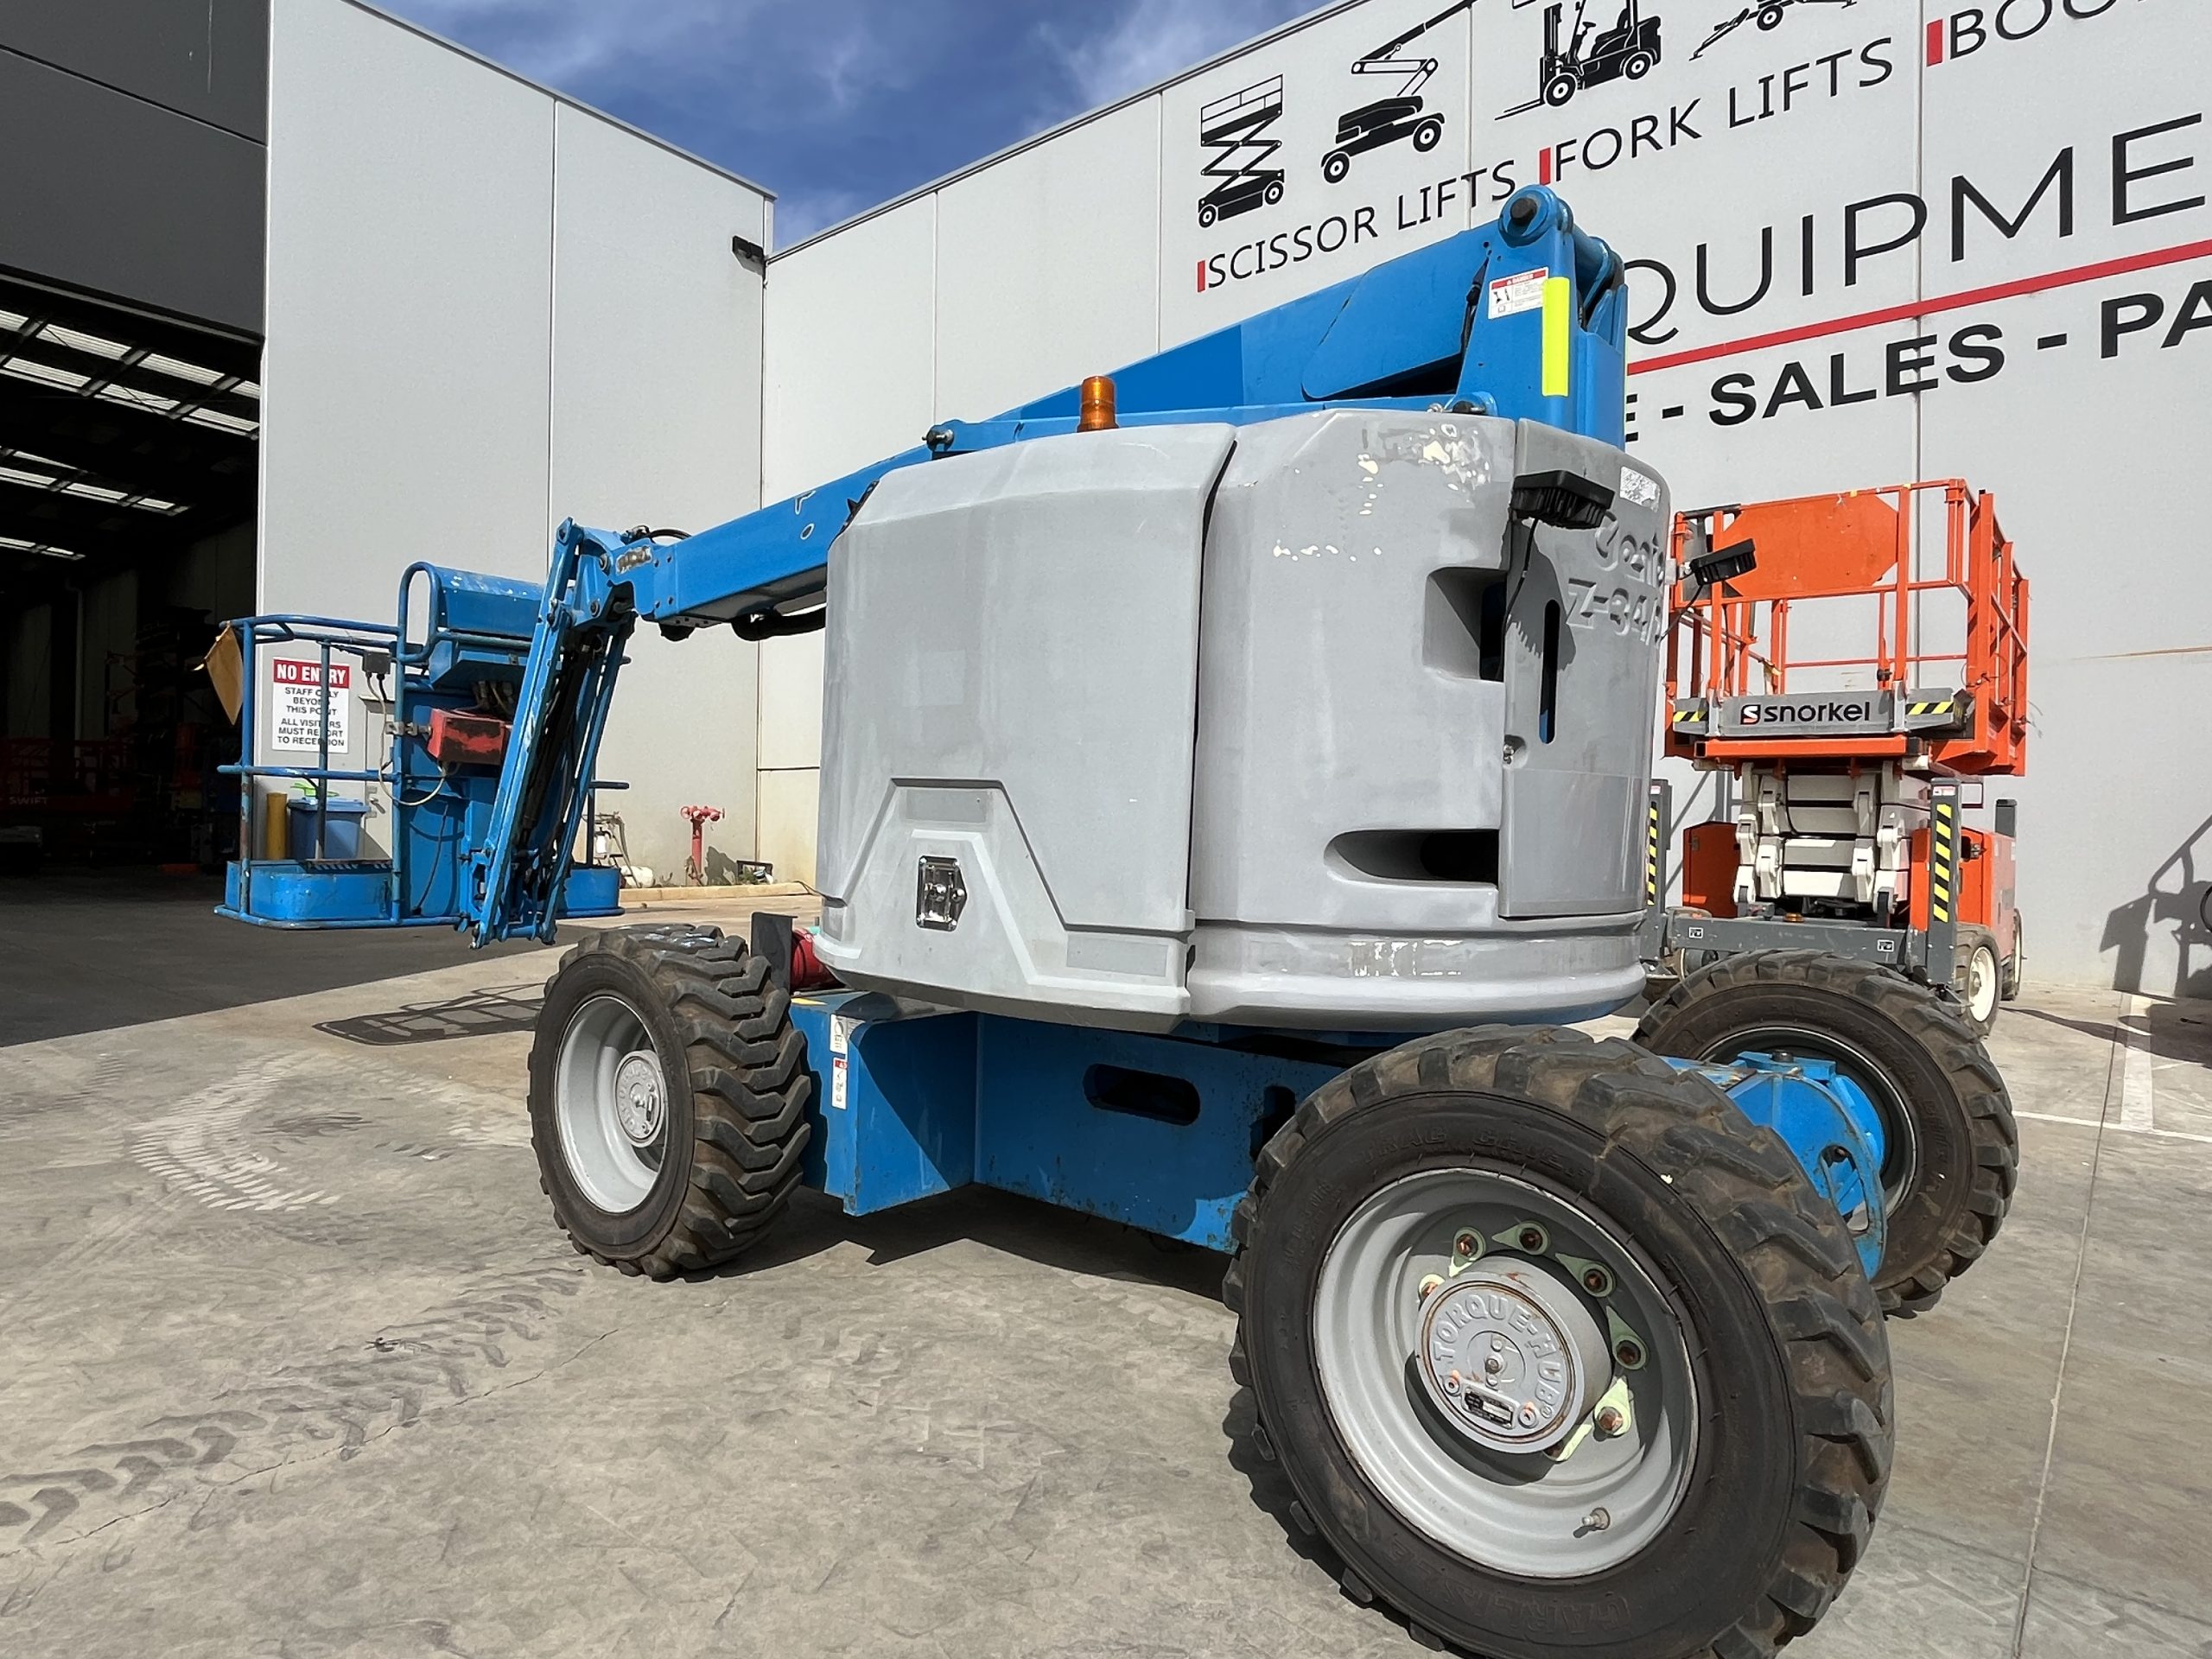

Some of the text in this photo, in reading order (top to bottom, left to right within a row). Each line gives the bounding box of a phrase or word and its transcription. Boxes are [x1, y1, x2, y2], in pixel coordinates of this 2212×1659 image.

[1950, 0, 2117, 60] BO
[1555, 36, 1892, 182] FORK LIFTS
[1208, 159, 1516, 289] SCISSOR LIFTS
[1708, 323, 2005, 426] SALES
[276, 664, 346, 684] NO ENRY
[285, 687, 339, 698] STAFF OLY
[293, 697, 330, 706] BEYO
[286, 705, 307, 714] THIS
[1764, 702, 1870, 722] snorkel
[281, 718, 341, 728] ALL VISITRS
[278, 727, 343, 738] MUST REORT
[292, 737, 345, 747] RECEION
